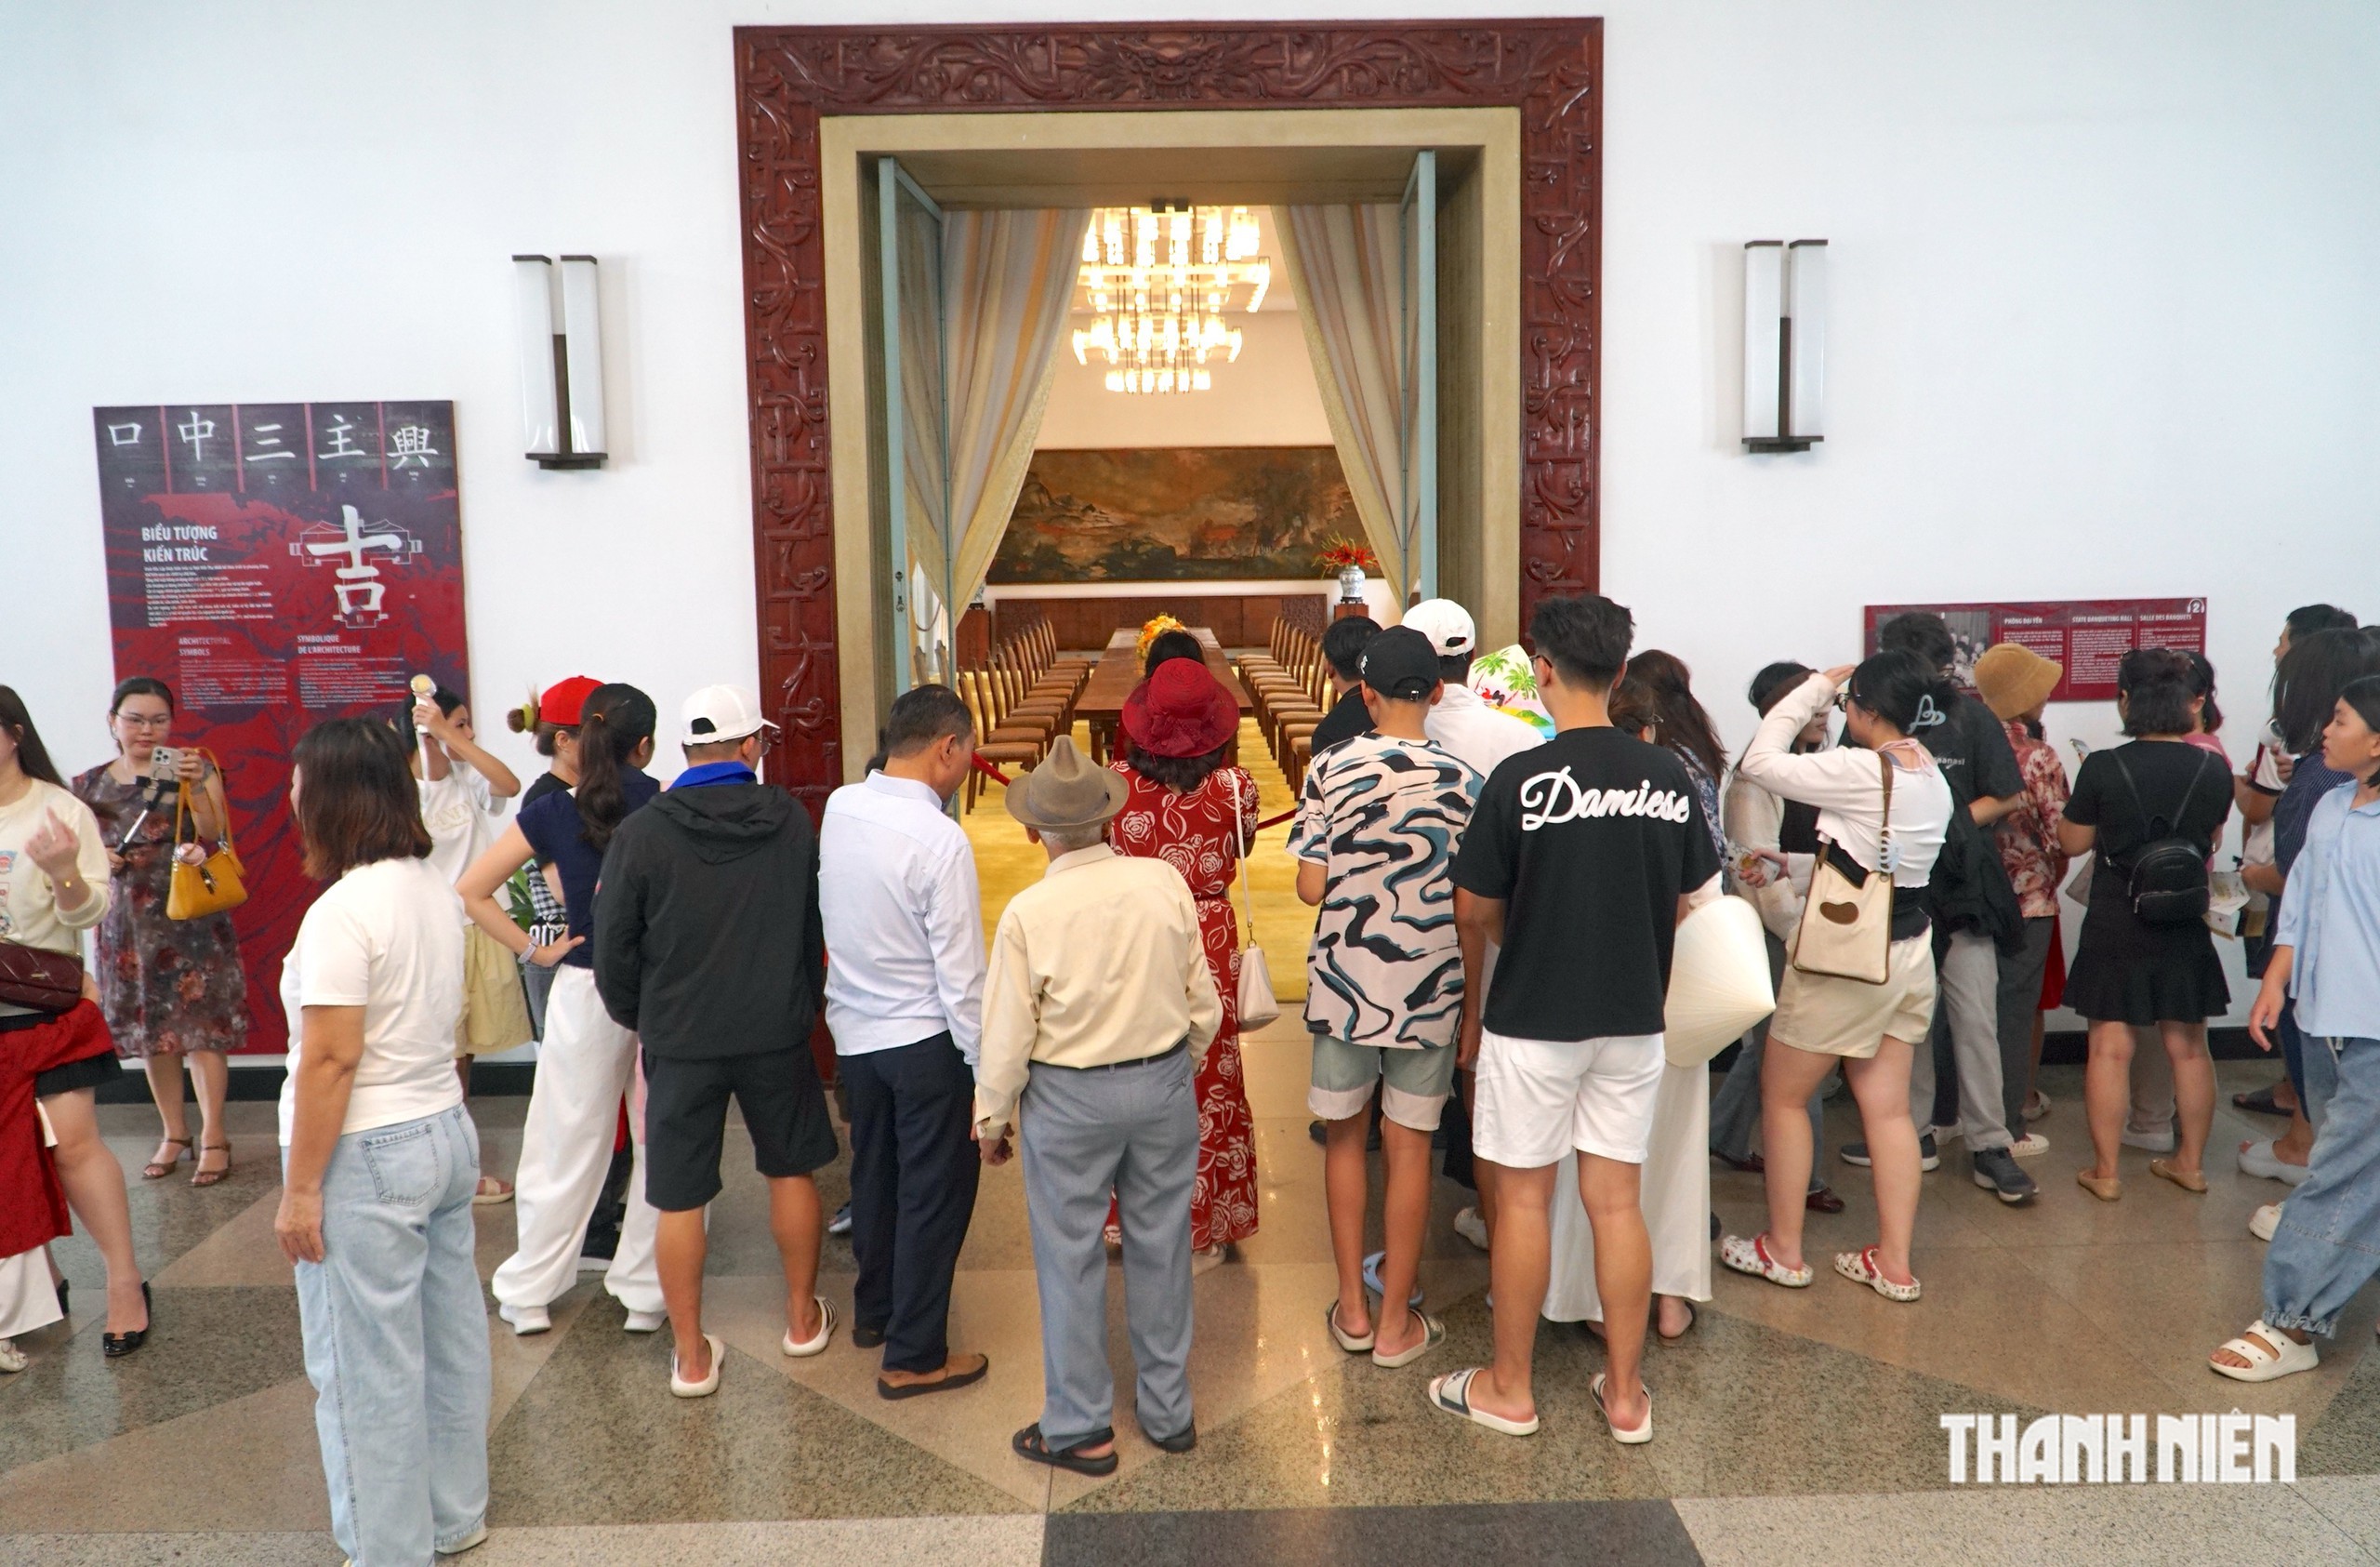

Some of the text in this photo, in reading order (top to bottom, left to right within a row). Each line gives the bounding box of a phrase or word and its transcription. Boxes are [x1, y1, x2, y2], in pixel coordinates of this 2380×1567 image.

[108, 410, 439, 470] 口 中 三 主 興
[174, 525, 218, 543] TƯỢNG
[2191, 602, 2200, 613] 2
[298, 634, 339, 644] SYMBOLIQUE
[178, 648, 210, 657] SYMBOLS
[298, 644, 362, 654] DE L'ARCHITECTURE
